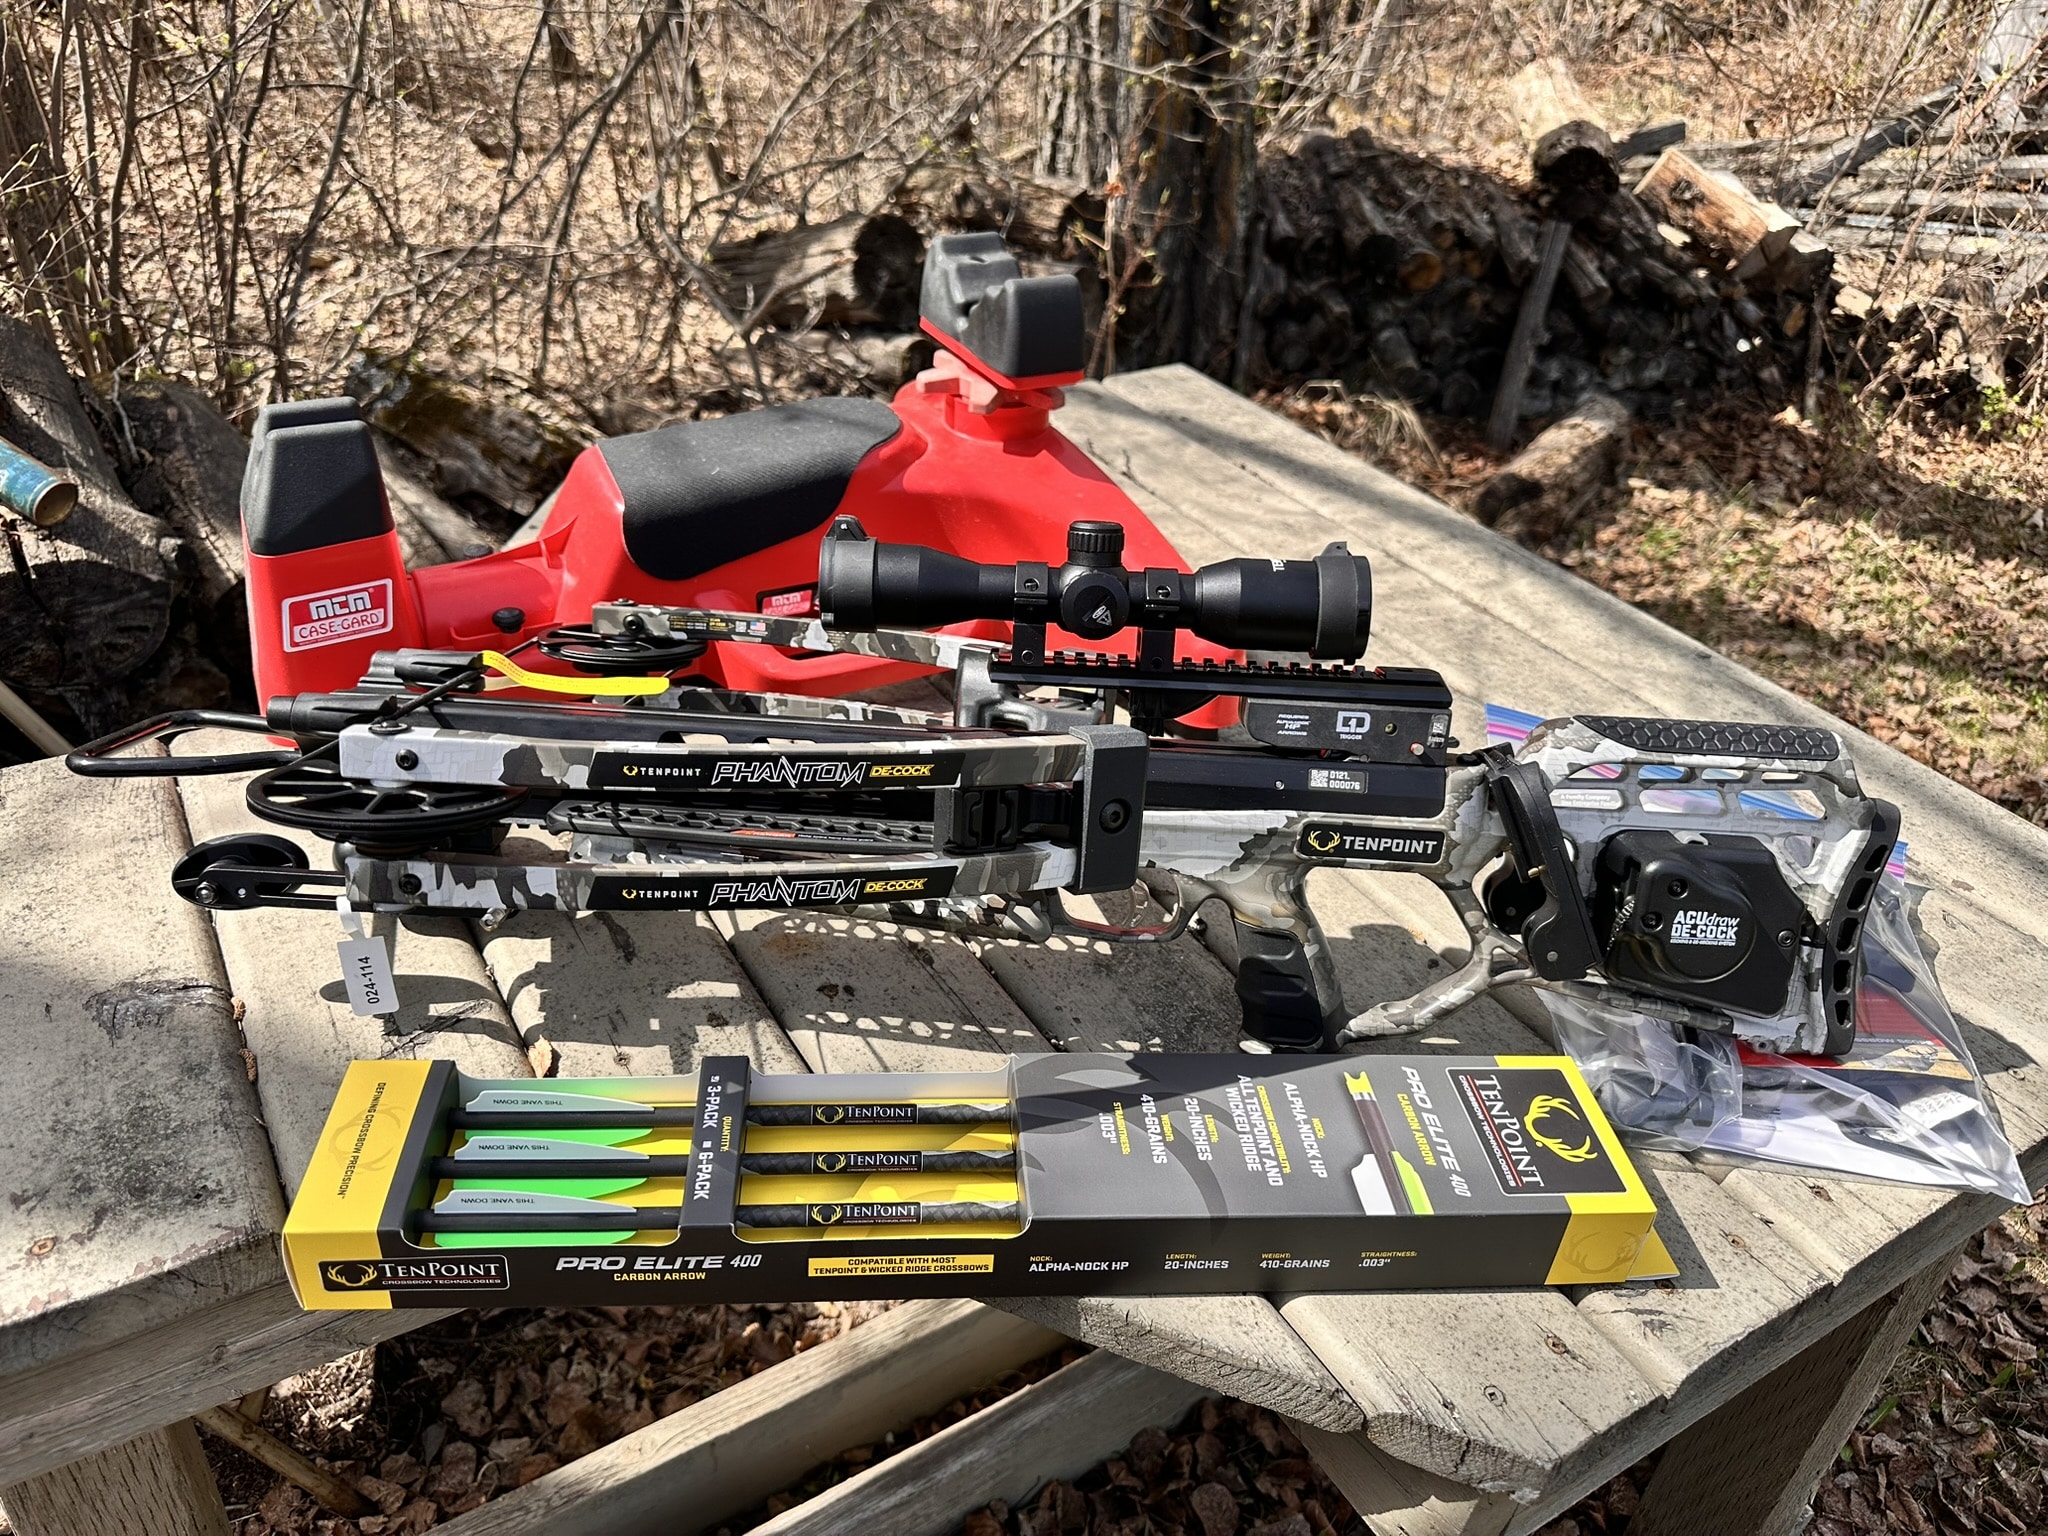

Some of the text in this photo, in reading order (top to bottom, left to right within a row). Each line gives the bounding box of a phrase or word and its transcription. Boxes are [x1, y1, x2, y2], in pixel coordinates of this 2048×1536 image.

[299, 612, 380, 639] CASE-GARD
[640, 767, 701, 777] TENPOINT
[711, 755, 867, 788] PHANTOM
[871, 764, 934, 776] DE-COCK
[1329, 780, 1361, 791] 000076
[1343, 836, 1437, 855] TENPOINT
[639, 890, 699, 898] TENPOINT
[709, 875, 861, 907] PHANTOM
[865, 878, 927, 892] DE-COCK
[1671, 924, 1738, 939] DE-COCK
[1673, 910, 1740, 926] ACUdraw
[357, 956, 380, 1004] 024-114
[367, 1082, 387, 1113] DEFINING
[702, 1085, 722, 1128] 3-PACK
[352, 1114, 374, 1154] CROSSBOW
[720, 1115, 732, 1152] QUANTITY:
[1140, 1094, 1168, 1164] 410-GRAINS
[1184, 1097, 1213, 1161] 20-INCHES
[1225, 1087, 1262, 1172] WICKED RIDGE
[1237, 1075, 1284, 1186] ALL TENPOINT AND
[1282, 1082, 1328, 1178] ALPHA-NOCK HP
[1397, 1093, 1437, 1166] CARBON ARROW
[1401, 1066, 1472, 1197] PRO ELITE 400
[1458, 1075, 1516, 1187] CROSSBOW TECHNOLOGIES
[693, 1151, 714, 1200] 6-PACK
[556, 1254, 762, 1271] PRO ELITE 400
[614, 1272, 706, 1281] CARBON ARROW
[814, 1266, 858, 1274] TENPOINT
[905, 1265, 932, 1273] RIDGE
[934, 1264, 989, 1272] CROSSBOWS
[848, 1258, 904, 1266] COMPATIBLE
[1029, 1261, 1129, 1272] ALPHA-NOCK HP
[1164, 1260, 1229, 1269] 20-INCHES
[1259, 1259, 1331, 1268] 410-GRAINS
